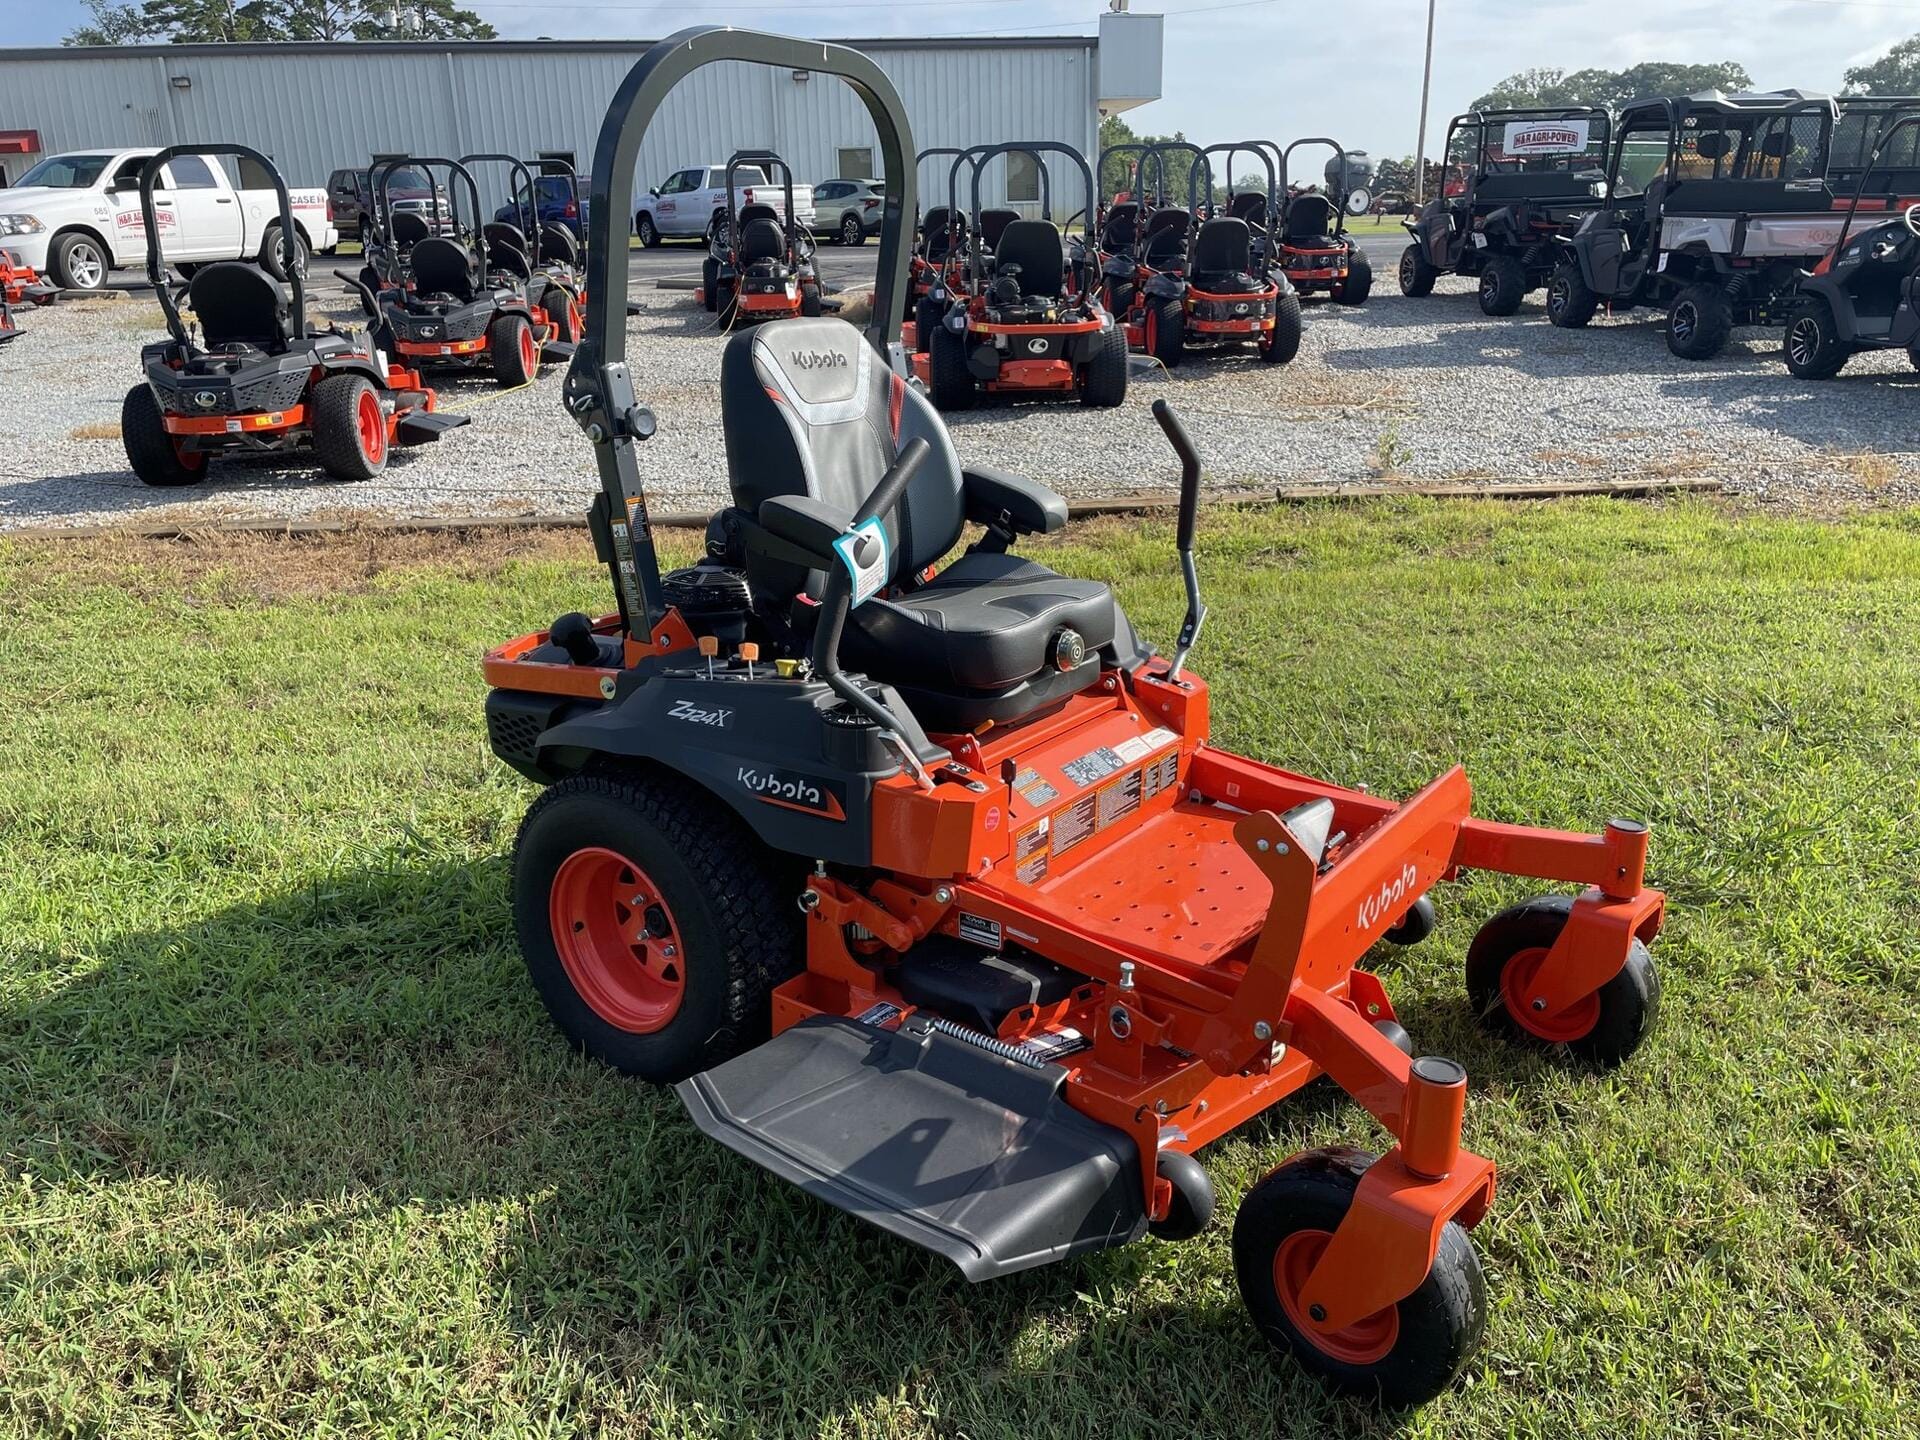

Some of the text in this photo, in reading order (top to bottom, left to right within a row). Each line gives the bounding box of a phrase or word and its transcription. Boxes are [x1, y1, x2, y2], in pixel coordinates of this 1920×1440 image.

[1532, 132, 1577, 143] AGRI-POWER
[289, 195, 316, 204] CASE
[118, 213, 132, 225] H&R
[791, 349, 848, 369] Kubota
[667, 700, 733, 728] Z724X
[737, 767, 820, 803] Kubota
[1358, 864, 1416, 929] Kubota
